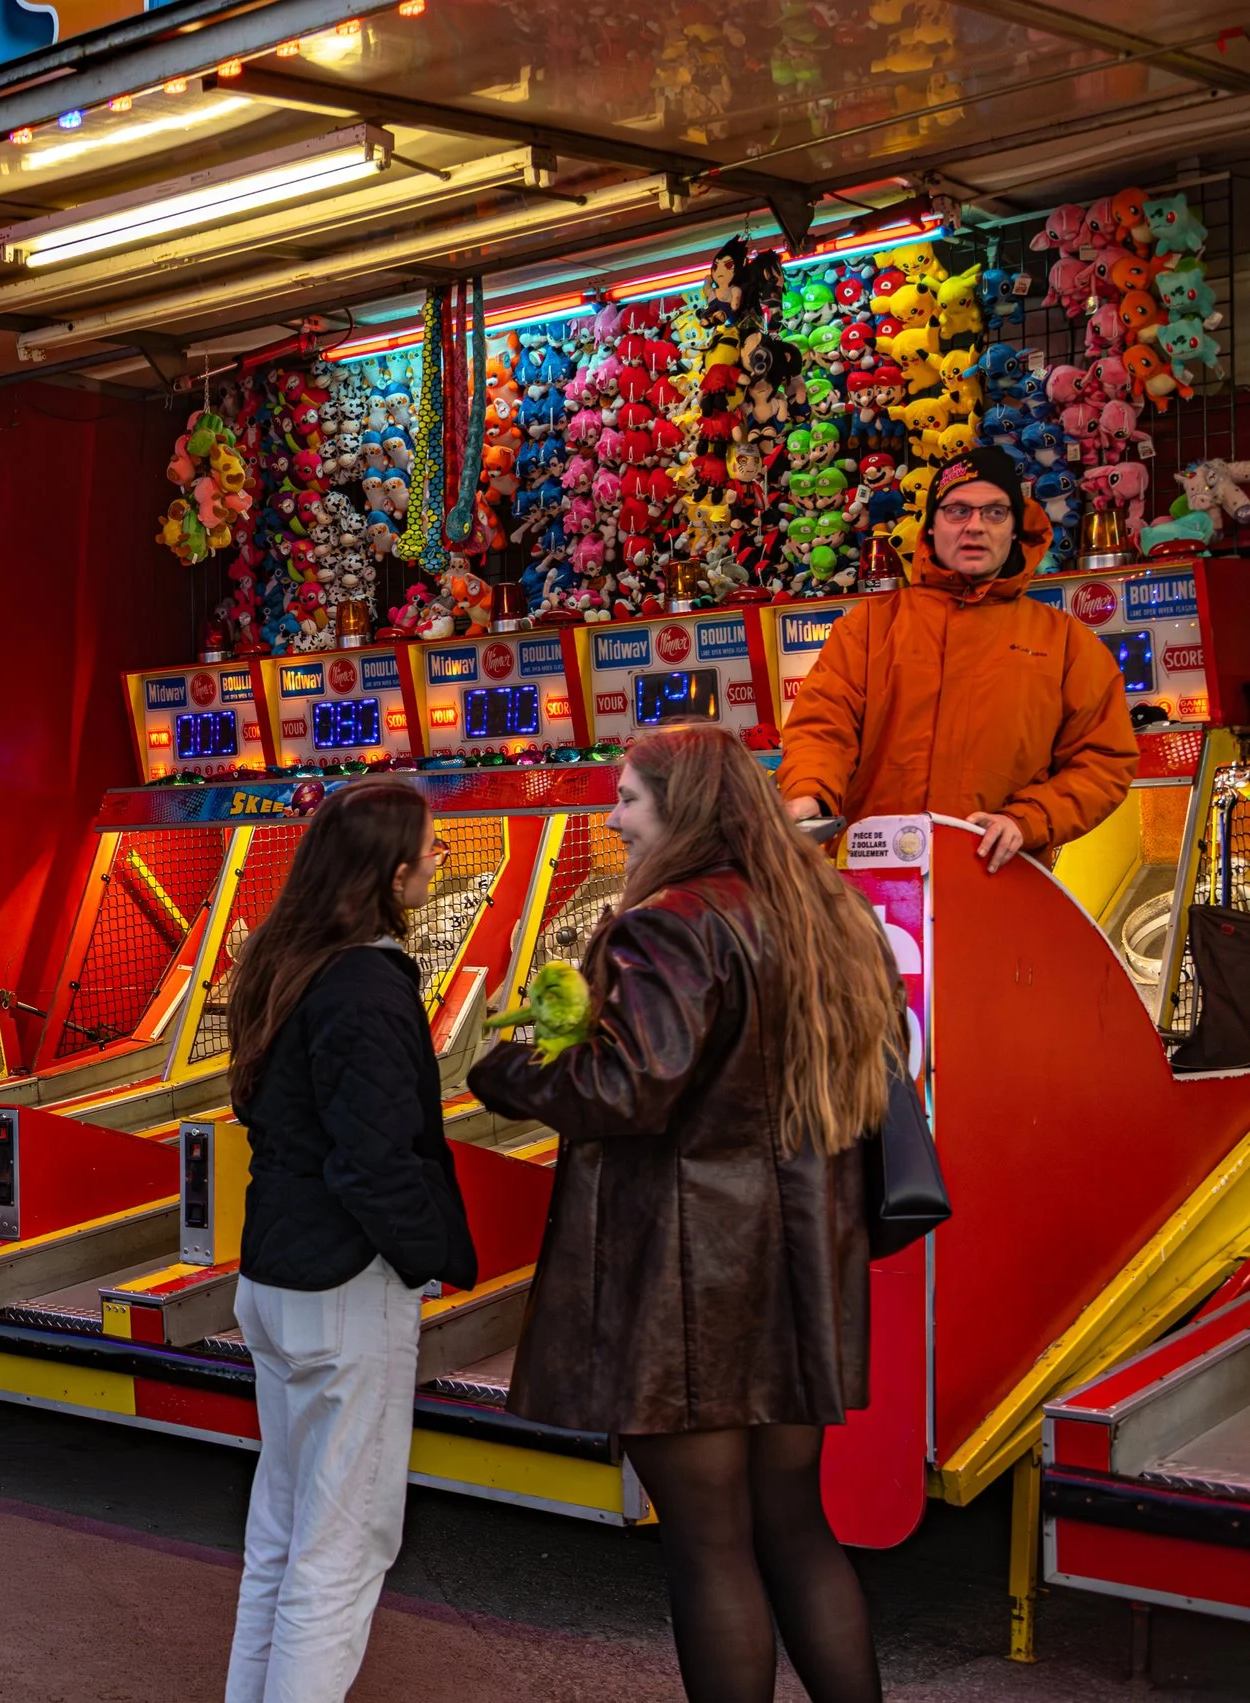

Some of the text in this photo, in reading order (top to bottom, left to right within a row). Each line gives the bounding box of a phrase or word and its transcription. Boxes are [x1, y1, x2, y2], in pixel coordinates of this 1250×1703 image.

[1130, 579, 1196, 605] BOWLING
[701, 625, 745, 646] BOWLIN
[786, 619, 832, 643] Midwa
[522, 644, 562, 664] BOWLIN
[597, 638, 648, 661] Midway
[431, 654, 476, 677] Midway
[1165, 649, 1204, 668] SCORE
[364, 660, 399, 678] BOWLIN
[282, 669, 323, 692] Midway
[148, 682, 186, 704] Midway
[729, 687, 755, 702] SCOR
[785, 681, 803, 697] YO
[547, 701, 570, 716] SCOR
[598, 696, 624, 711] YOUR
[1180, 699, 1207, 707] GAME
[1181, 706, 1207, 714] OVER
[387, 714, 407, 728] SCOR
[431, 709, 455, 723] YOUR
[243, 725, 261, 739] SCO
[284, 722, 305, 736] YOUR
[150, 732, 169, 746] YOUR
[229, 791, 285, 815] SKEE
[874, 831, 883, 839] DE
[851, 840, 887, 849] 2 DOLLARS
